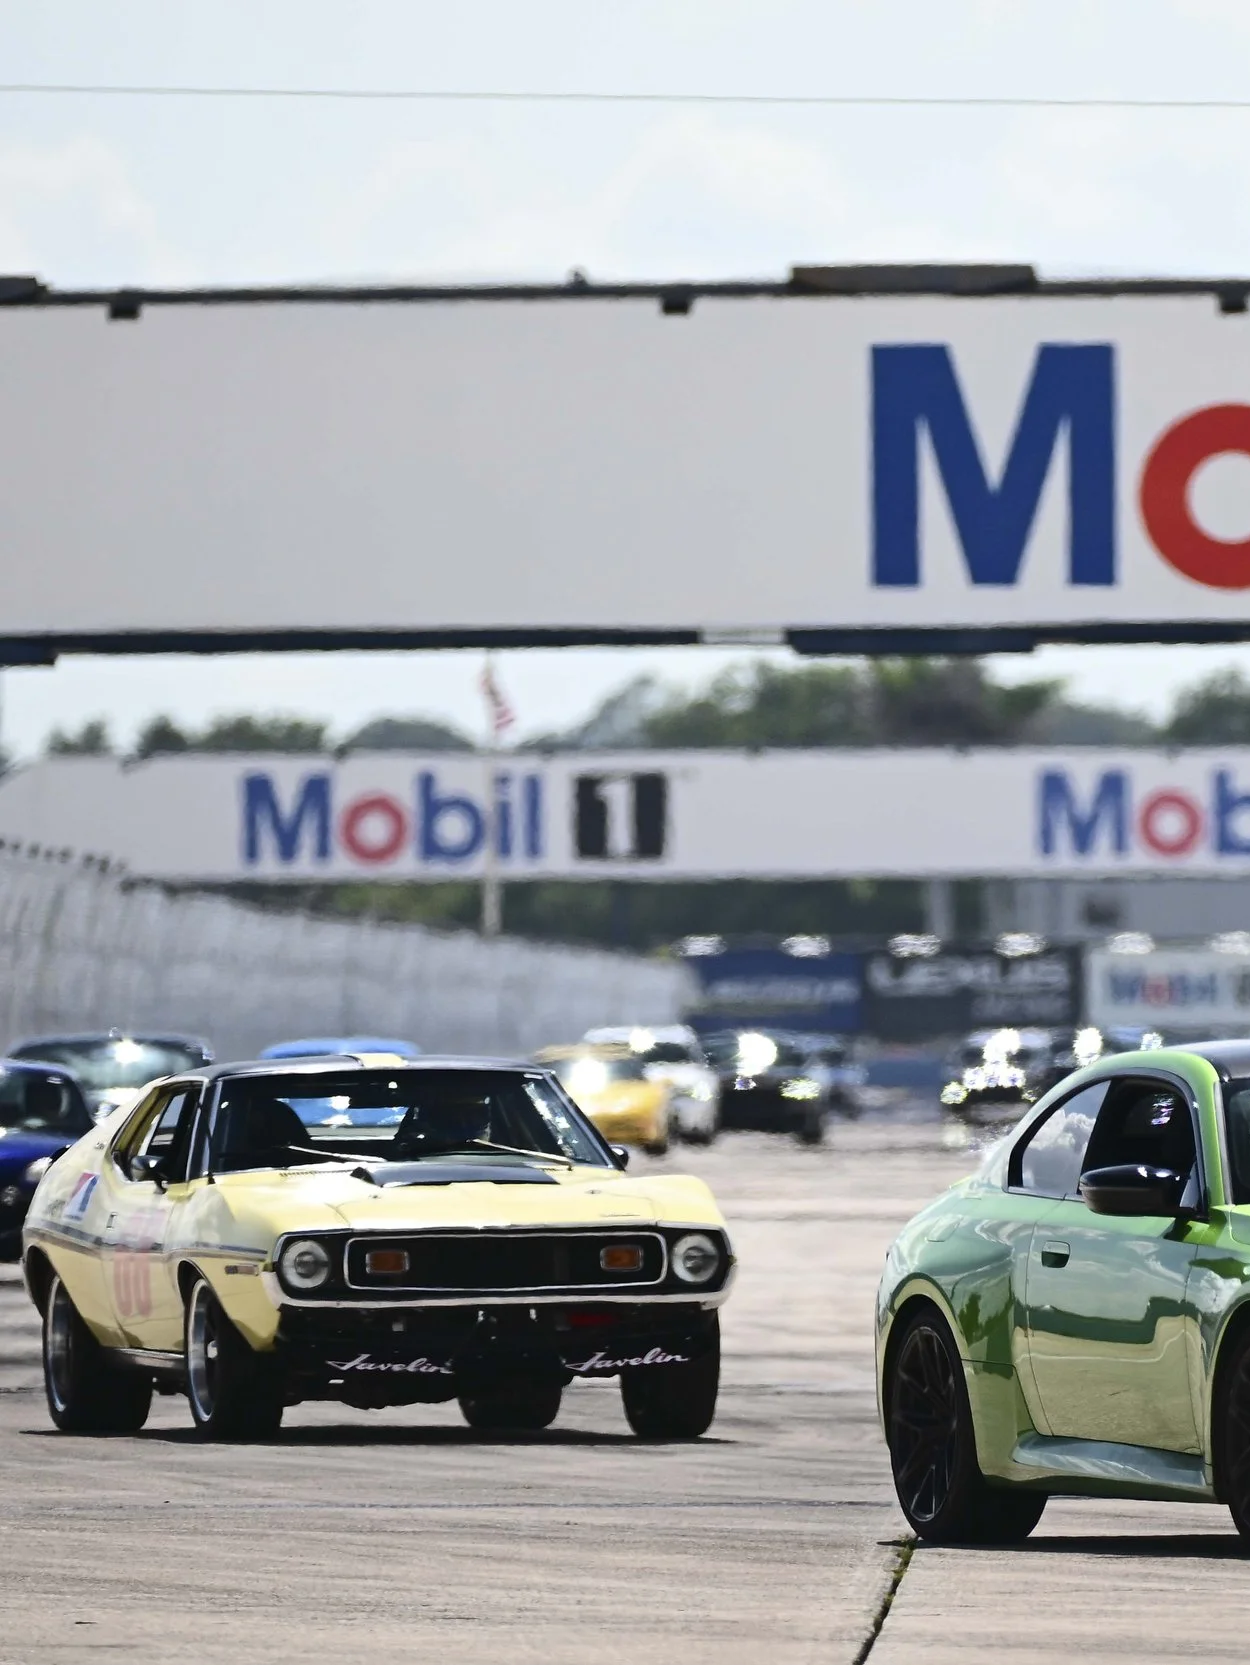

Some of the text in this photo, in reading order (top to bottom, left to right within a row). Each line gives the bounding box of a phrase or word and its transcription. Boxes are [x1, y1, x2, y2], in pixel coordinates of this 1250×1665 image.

[242, 770, 542, 864] Mobil
[326, 1353, 454, 1375] Javelin
[566, 1347, 691, 1372] Javelin
